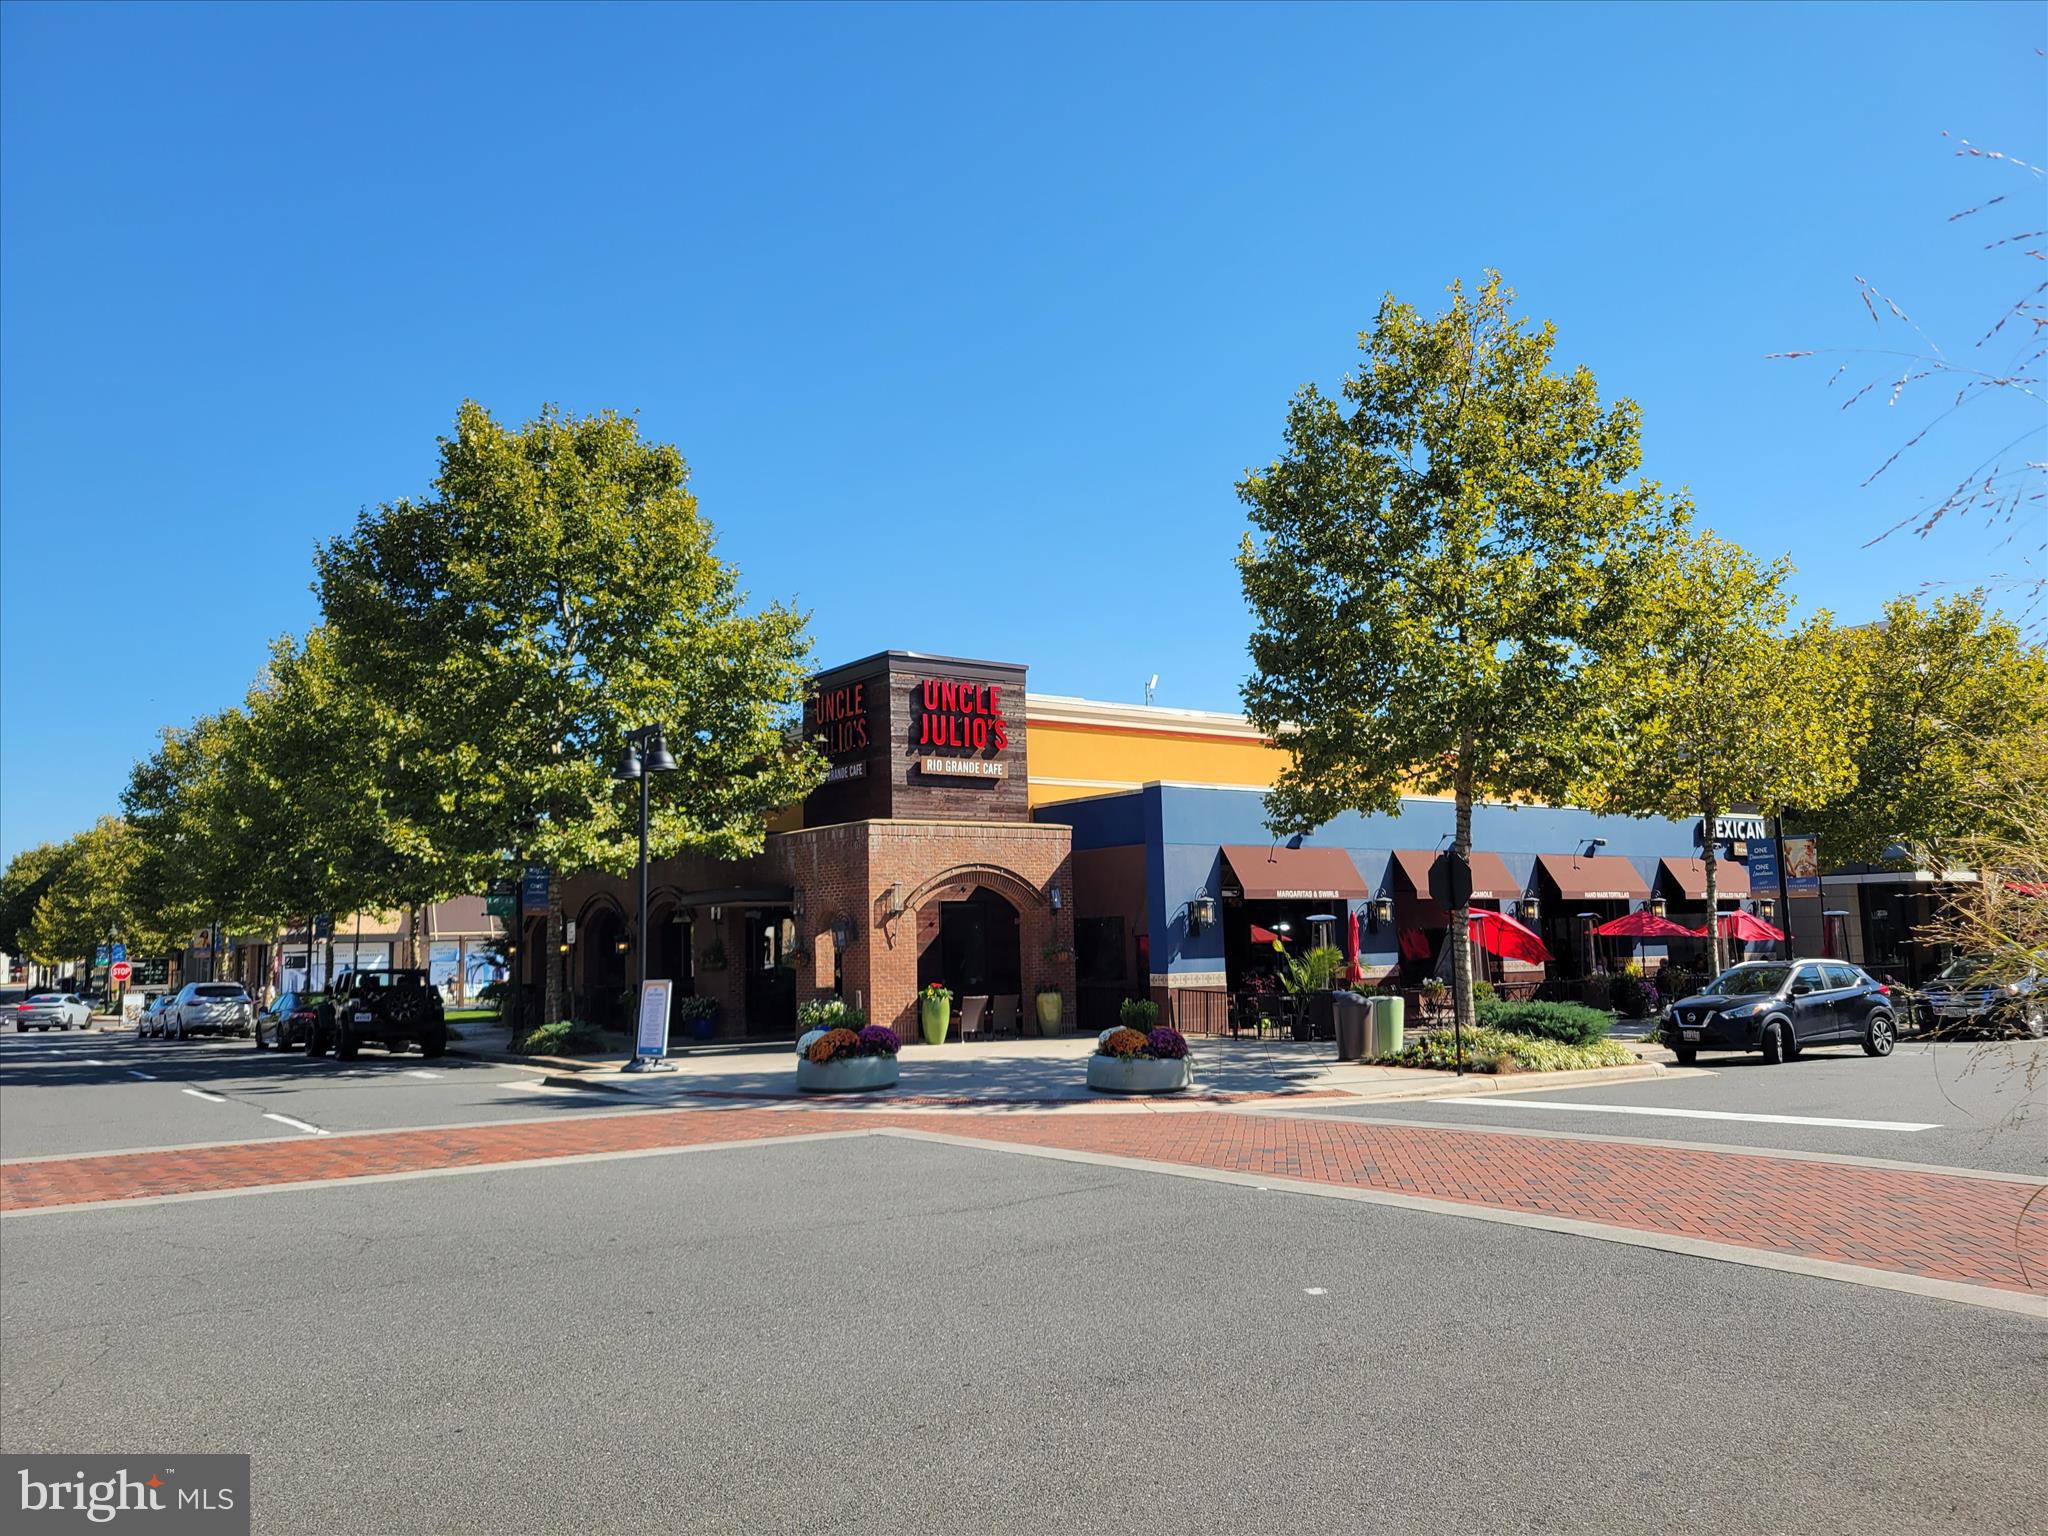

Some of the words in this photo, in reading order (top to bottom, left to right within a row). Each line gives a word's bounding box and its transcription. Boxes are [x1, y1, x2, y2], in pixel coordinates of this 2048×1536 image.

[816, 683, 863, 725] UNCLE
[922, 679, 1003, 715] UNCLE
[817, 718, 867, 755] ULIO'S
[920, 713, 1009, 750] JULIO'S
[827, 765, 848, 780] RANDE
[849, 763, 863, 776] CAFE
[927, 759, 942, 771] RIO
[945, 761, 980, 774] GRANDE
[983, 763, 1003, 775] CAFE
[1276, 890, 1312, 898] MARGARITAS
[112, 967, 131, 976] STOP
